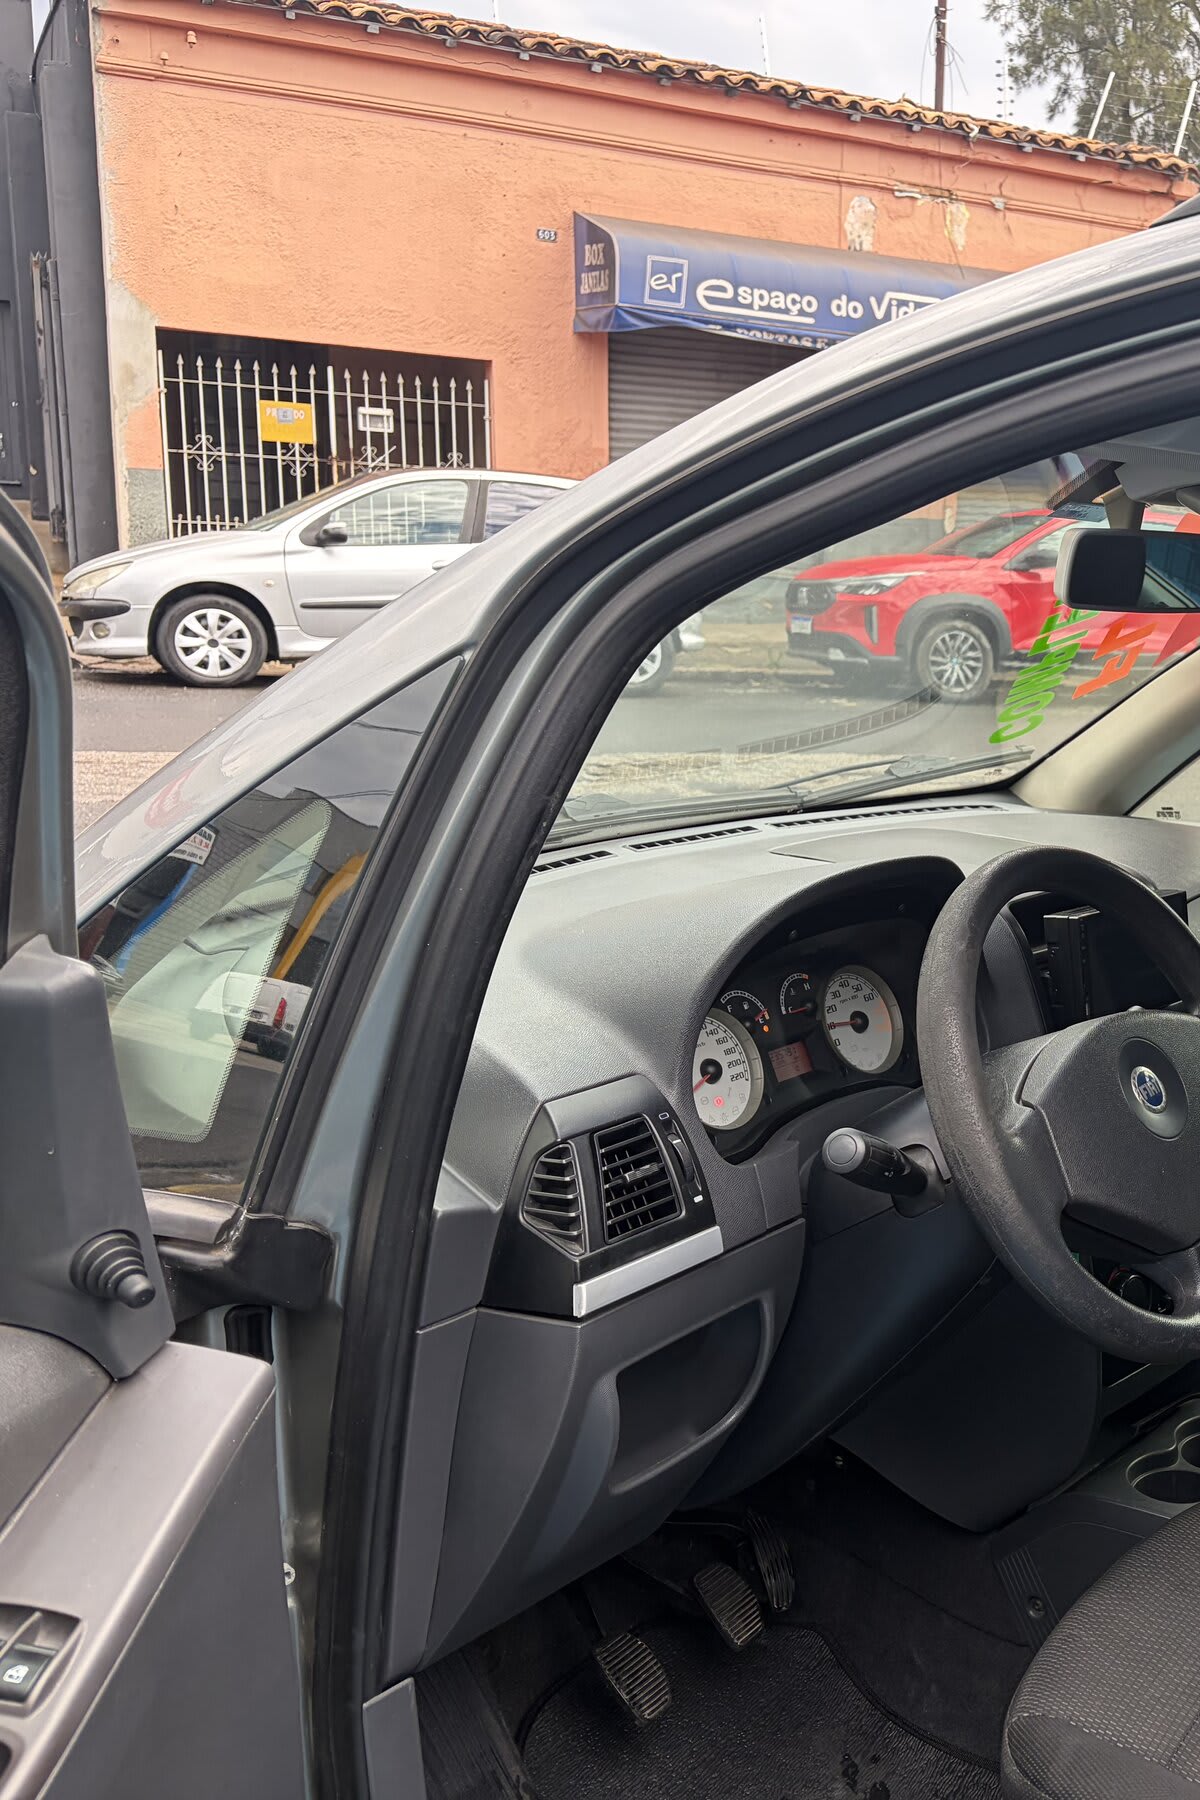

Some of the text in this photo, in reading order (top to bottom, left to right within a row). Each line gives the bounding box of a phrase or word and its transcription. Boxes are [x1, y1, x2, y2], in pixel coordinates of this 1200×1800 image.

[584, 243, 605, 266] BOX
[580, 269, 610, 295] JANELAS
[830, 294, 864, 319] do
[869, 290, 941, 322] Vid
[838, 979, 850, 989] 40
[851, 983, 863, 993] 50
[830, 990, 842, 1000] 30
[863, 992, 875, 1002] 60
[826, 1004, 837, 1014] 20
[705, 1028, 719, 1037] 140
[715, 1036, 729, 1046] 160
[723, 1046, 737, 1056] 180
[726, 1058, 742, 1069] 200
[729, 1071, 745, 1082] 220
